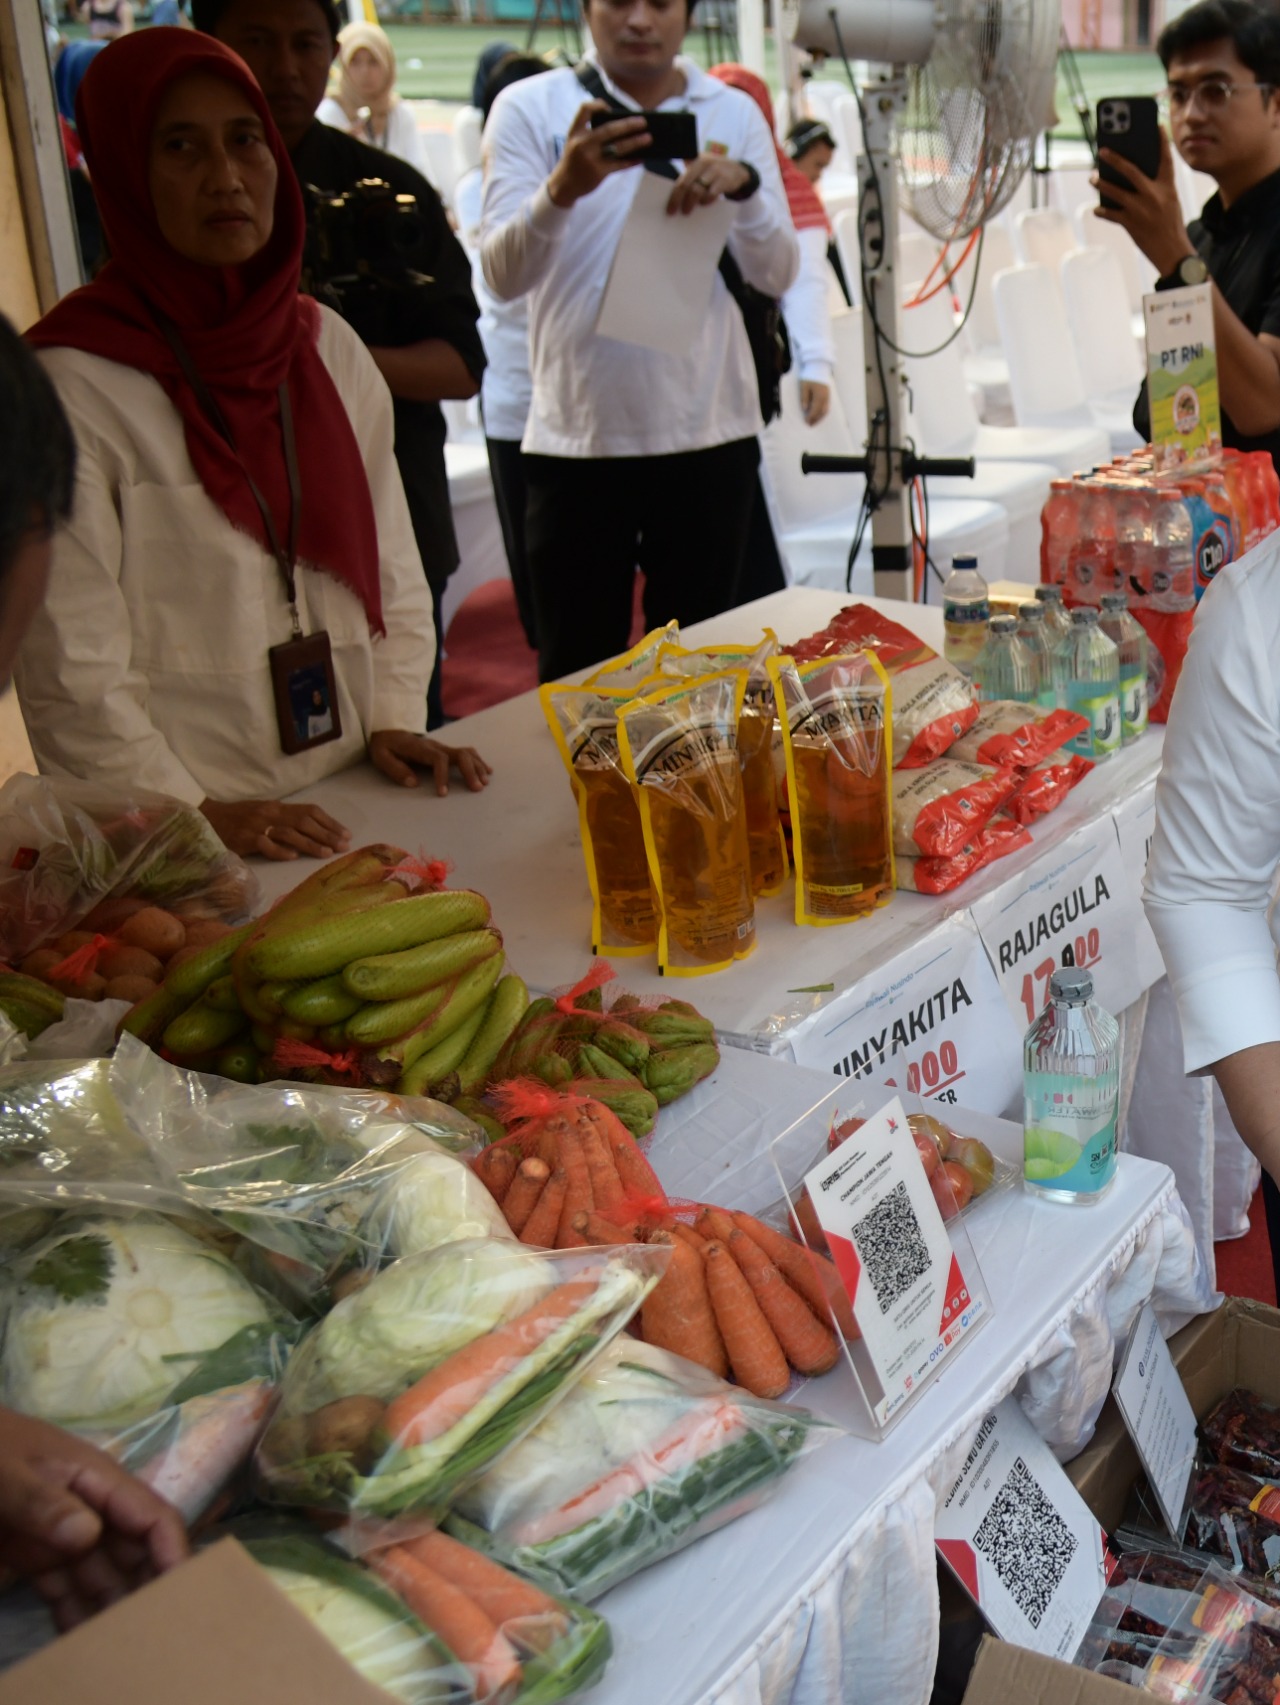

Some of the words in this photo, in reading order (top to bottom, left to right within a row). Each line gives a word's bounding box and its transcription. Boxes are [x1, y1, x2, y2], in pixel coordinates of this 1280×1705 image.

[1161, 349, 1177, 368] PT
[1181, 342, 1204, 364] RNI
[999, 873, 1111, 974] RAJAGULA
[890, 972, 914, 992] Nusindo
[832, 977, 973, 1081] INYAKITA
[821, 1170, 841, 1191] QRIS
[841, 1178, 864, 1202] CHAMPION
[863, 1166, 877, 1181] JAWA
[876, 1151, 893, 1168] TENGAH
[929, 1342, 944, 1362] OVO
